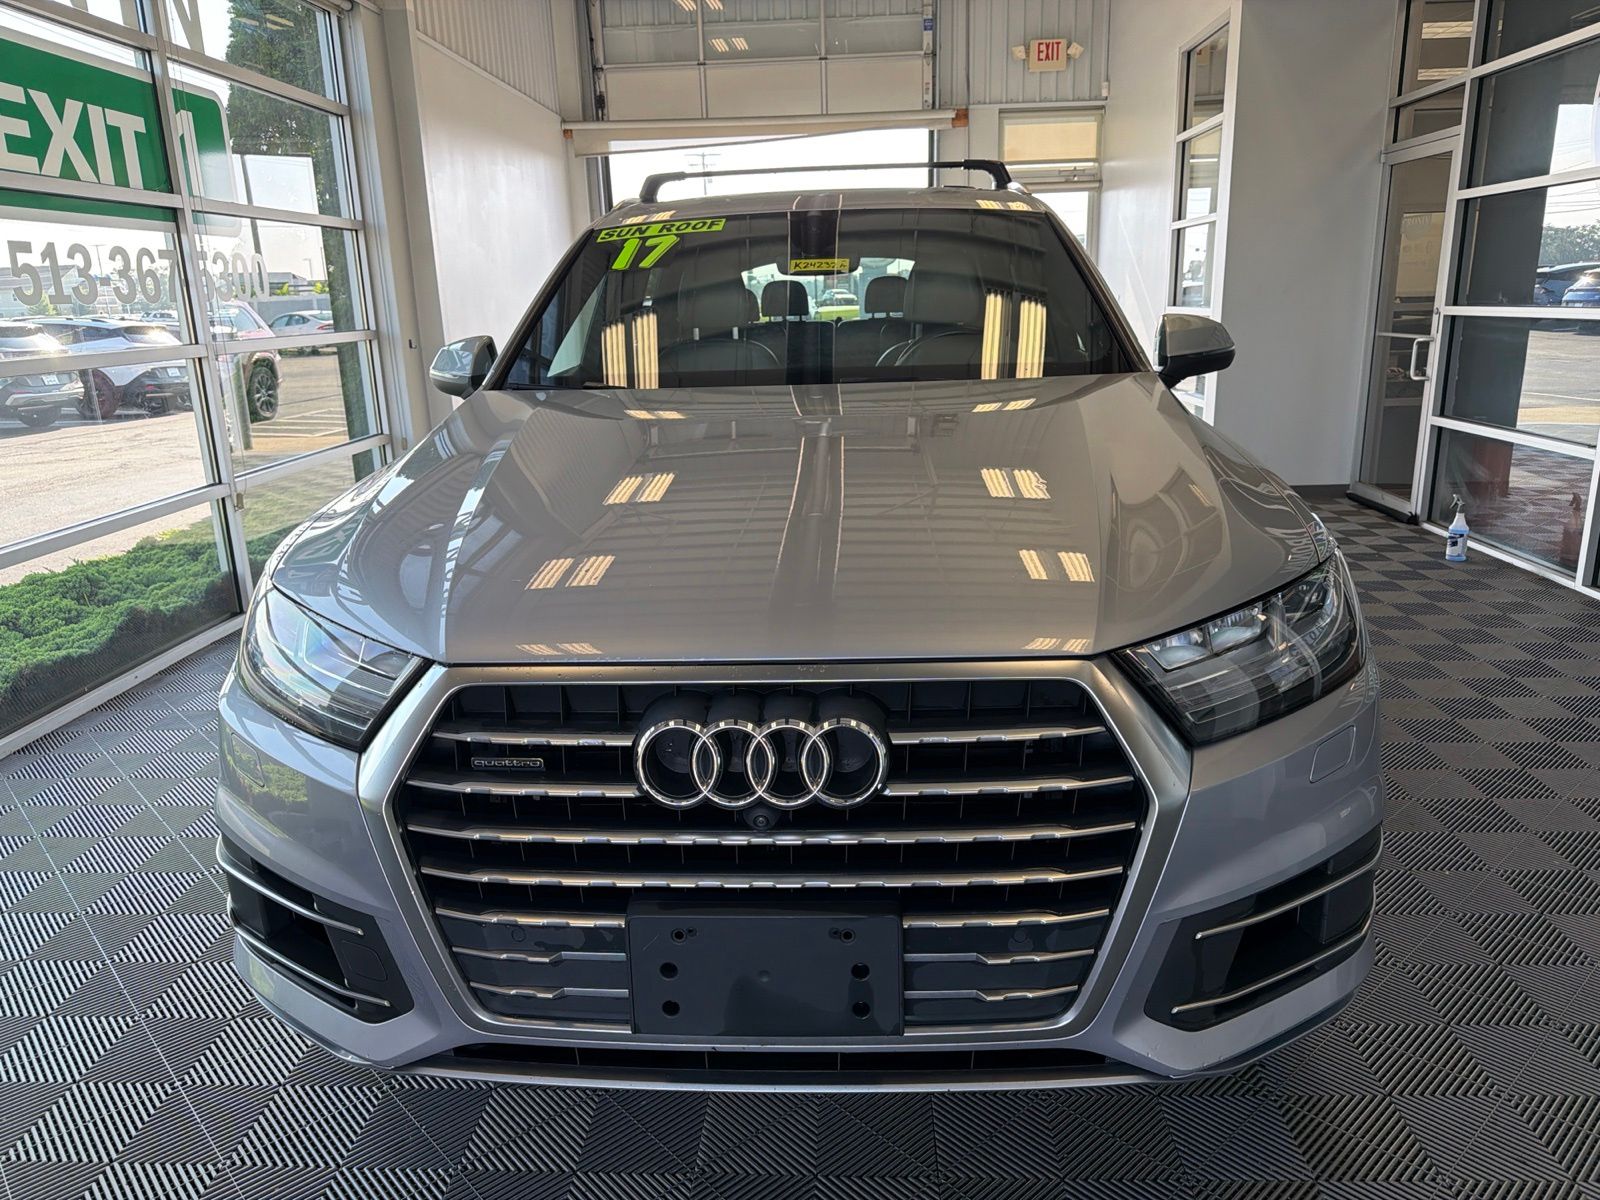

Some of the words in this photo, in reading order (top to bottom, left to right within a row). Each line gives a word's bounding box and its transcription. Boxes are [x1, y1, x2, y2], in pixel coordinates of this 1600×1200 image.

[1037, 41, 1062, 62] EXIT
[0, 81, 147, 190] EXIT
[600, 226, 651, 240] SUN
[658, 219, 723, 233] ROOF
[611, 234, 680, 270] 17
[474, 760, 540, 768] quattro
